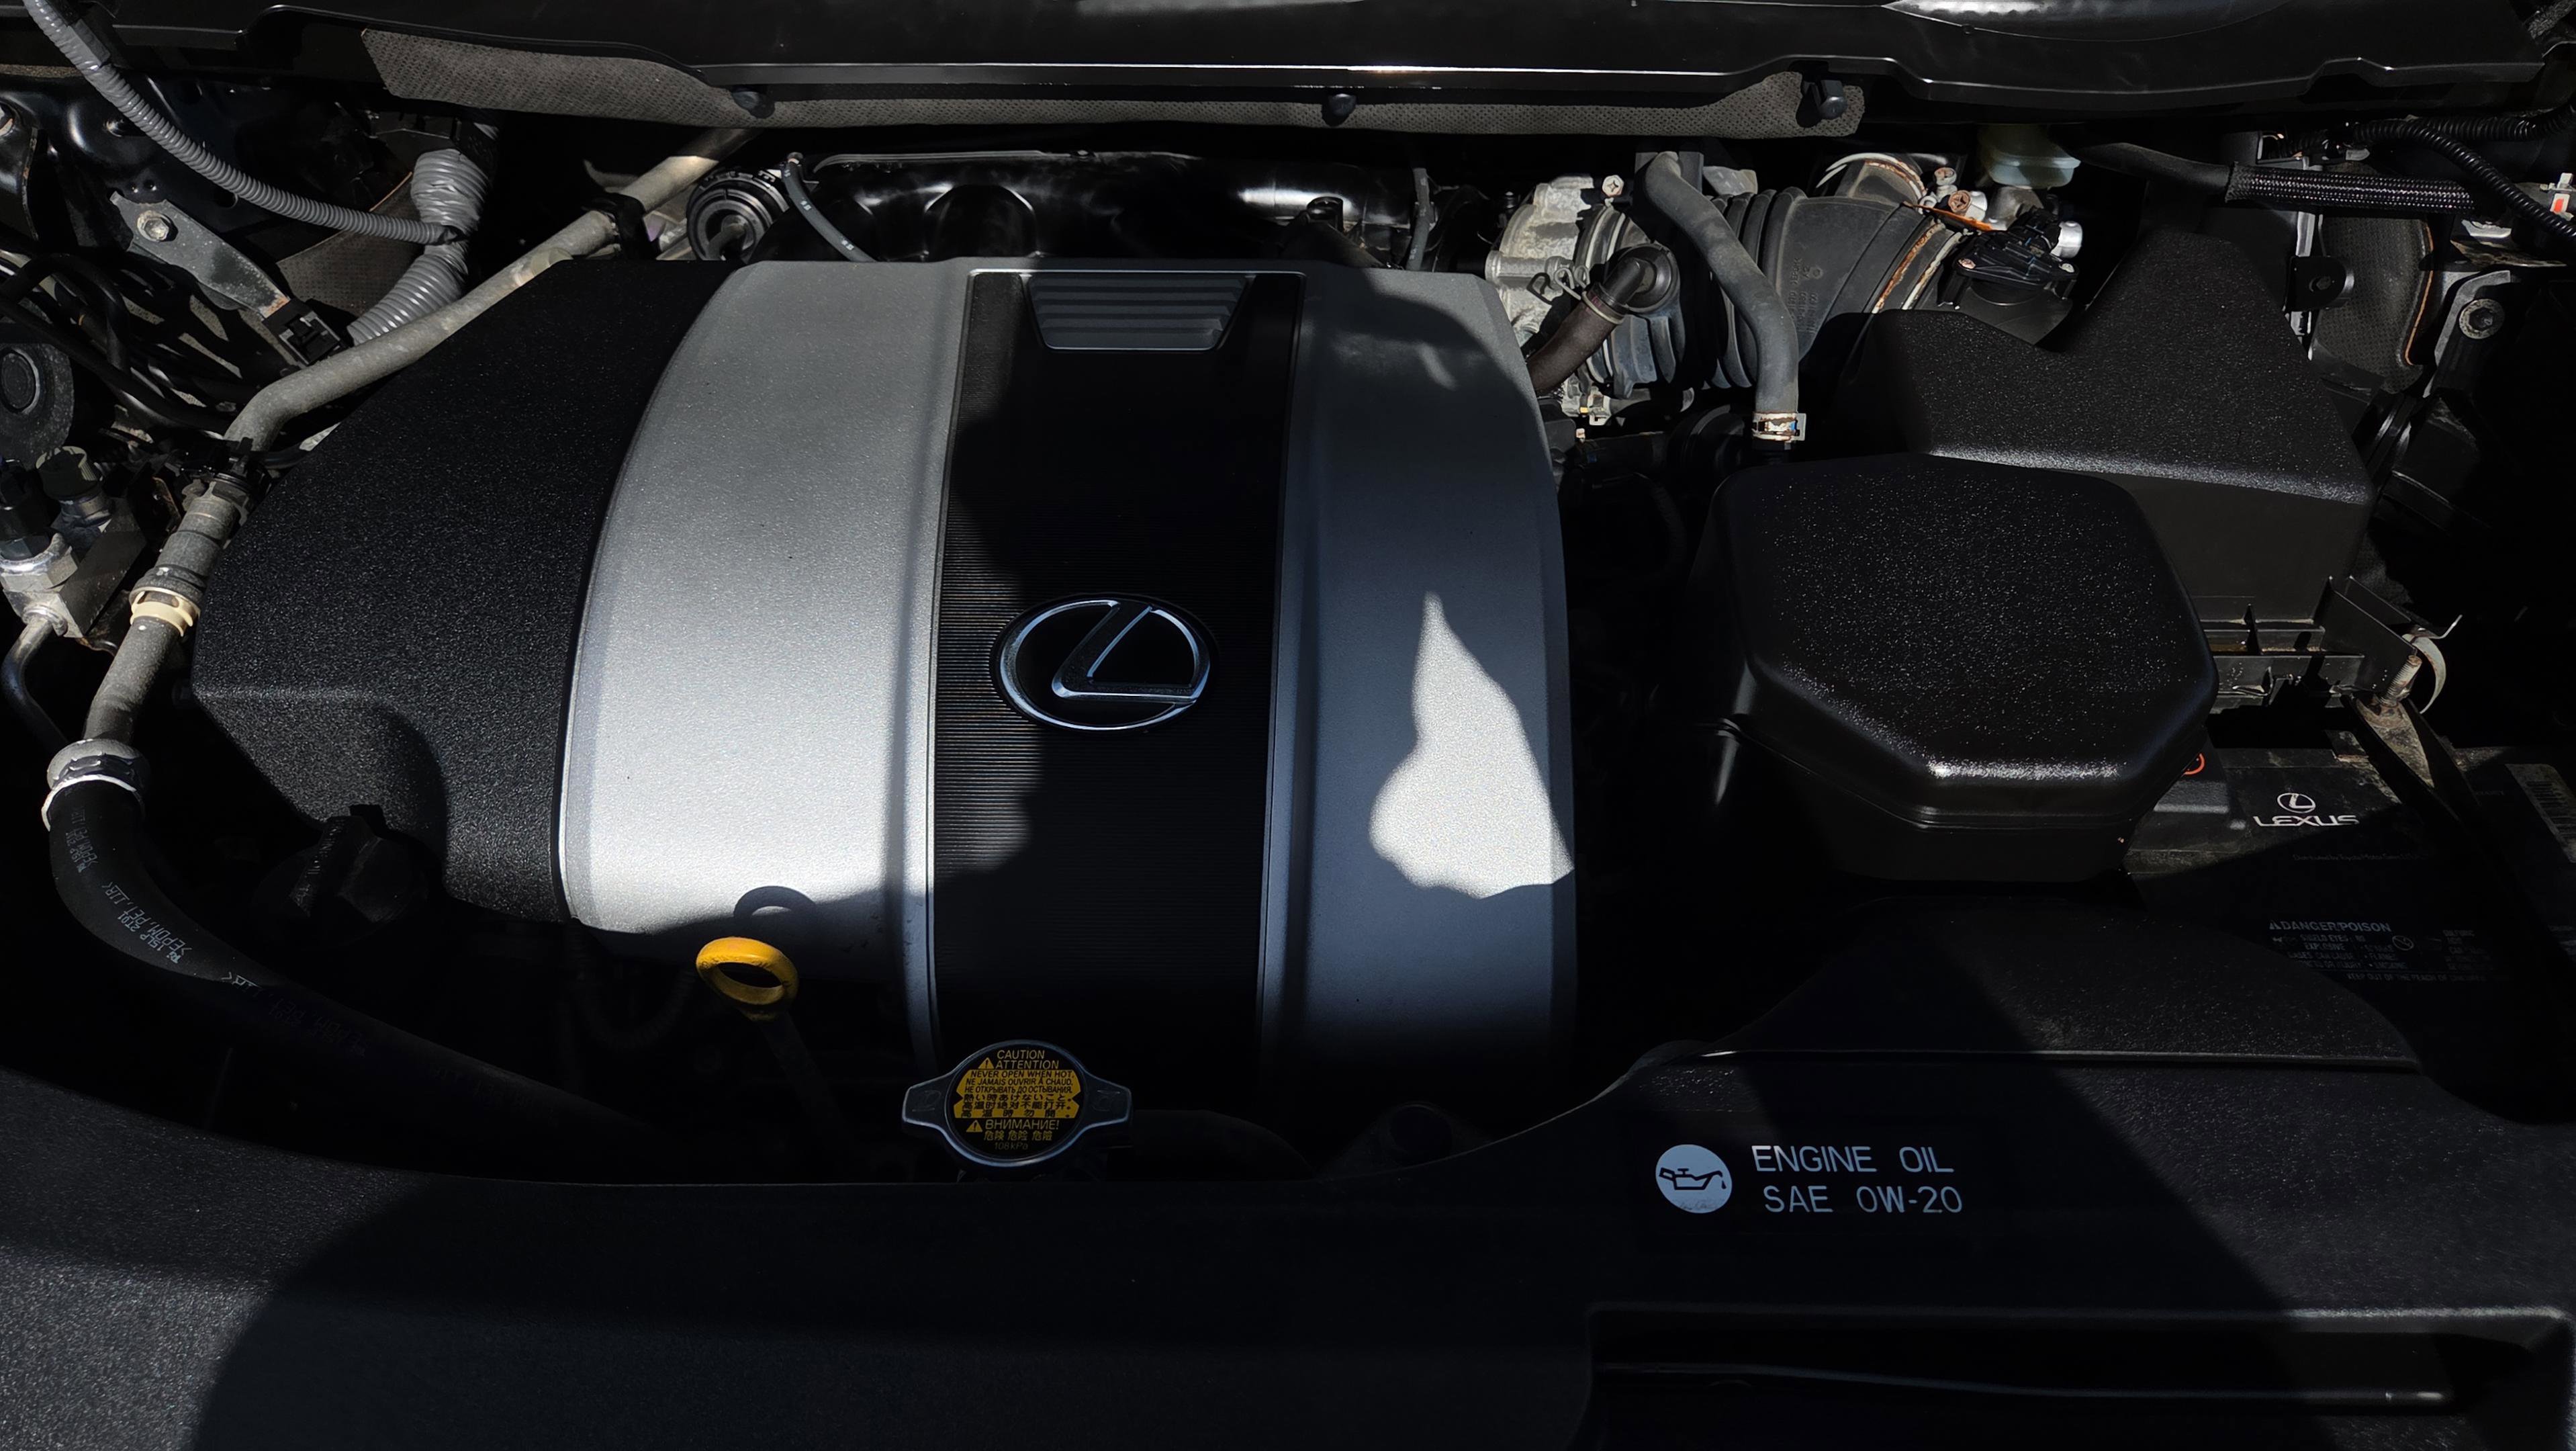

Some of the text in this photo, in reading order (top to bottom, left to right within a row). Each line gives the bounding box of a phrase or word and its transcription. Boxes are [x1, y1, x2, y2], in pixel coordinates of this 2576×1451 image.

[2252, 815, 2360, 827] LEXUS
[997, 1049, 1046, 1059] CAUTION
[995, 1060, 1060, 1069] ATTENTION
[1046, 1078, 1073, 1086] CHAUD.
[985, 1119, 1060, 1130] ВНИМАНИЕ!
[1751, 1145, 1956, 1174] ENGINE OIL
[1762, 1184, 1964, 1214] SAE 0W-20
